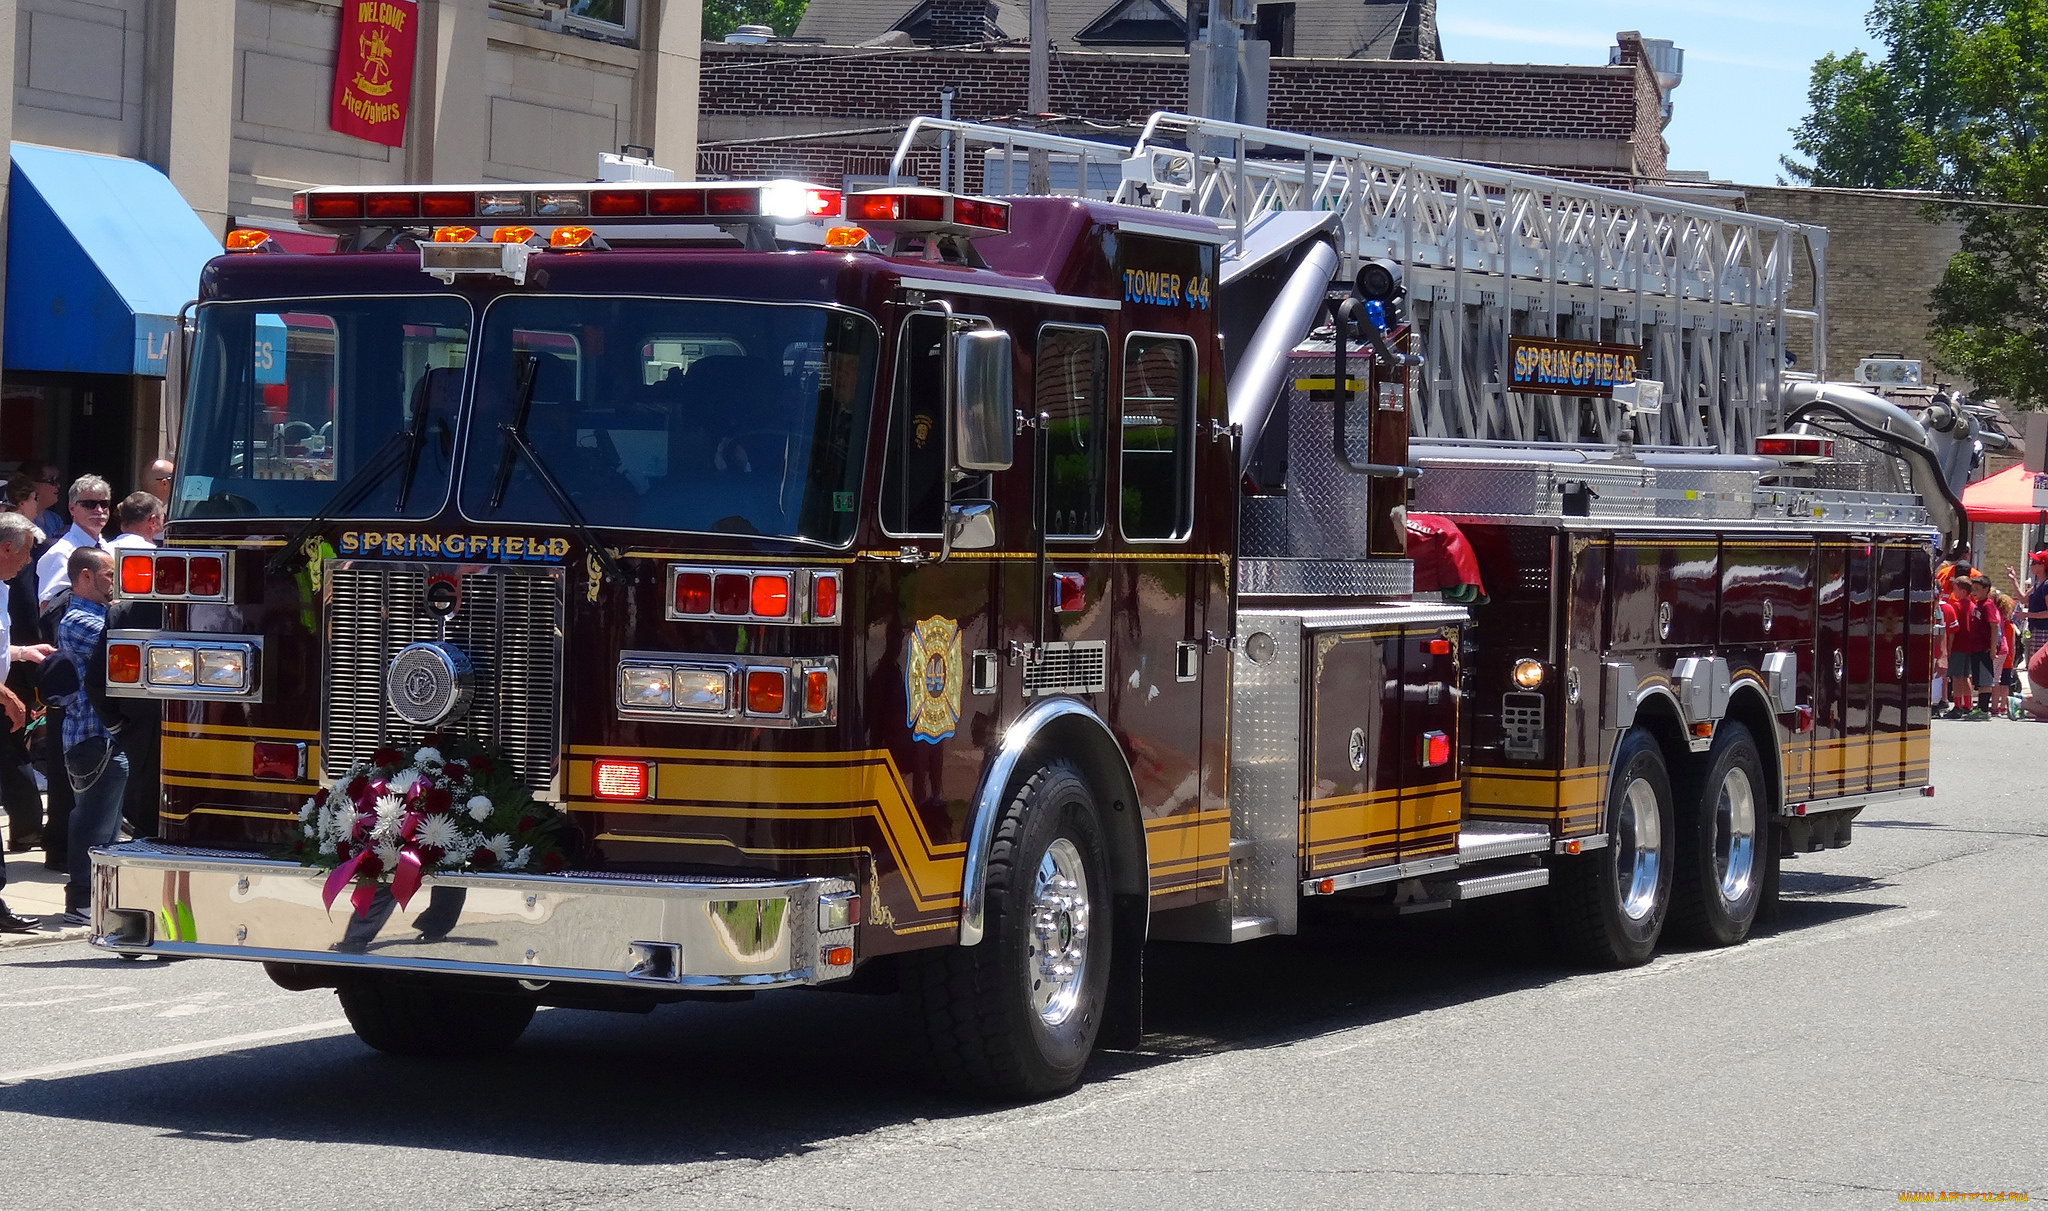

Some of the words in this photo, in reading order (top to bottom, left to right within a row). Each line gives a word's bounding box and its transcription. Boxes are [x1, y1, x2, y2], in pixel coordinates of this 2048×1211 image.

[358, 2, 406, 32] WELCOME
[341, 87, 400, 124] Firefighters
[1123, 269, 1181, 305] TOWER
[1186, 276, 1210, 308] 44
[1515, 346, 1637, 384] SPRINGFIELD
[341, 531, 572, 560] SPRINGFIELD
[927, 658, 945, 687] 44
